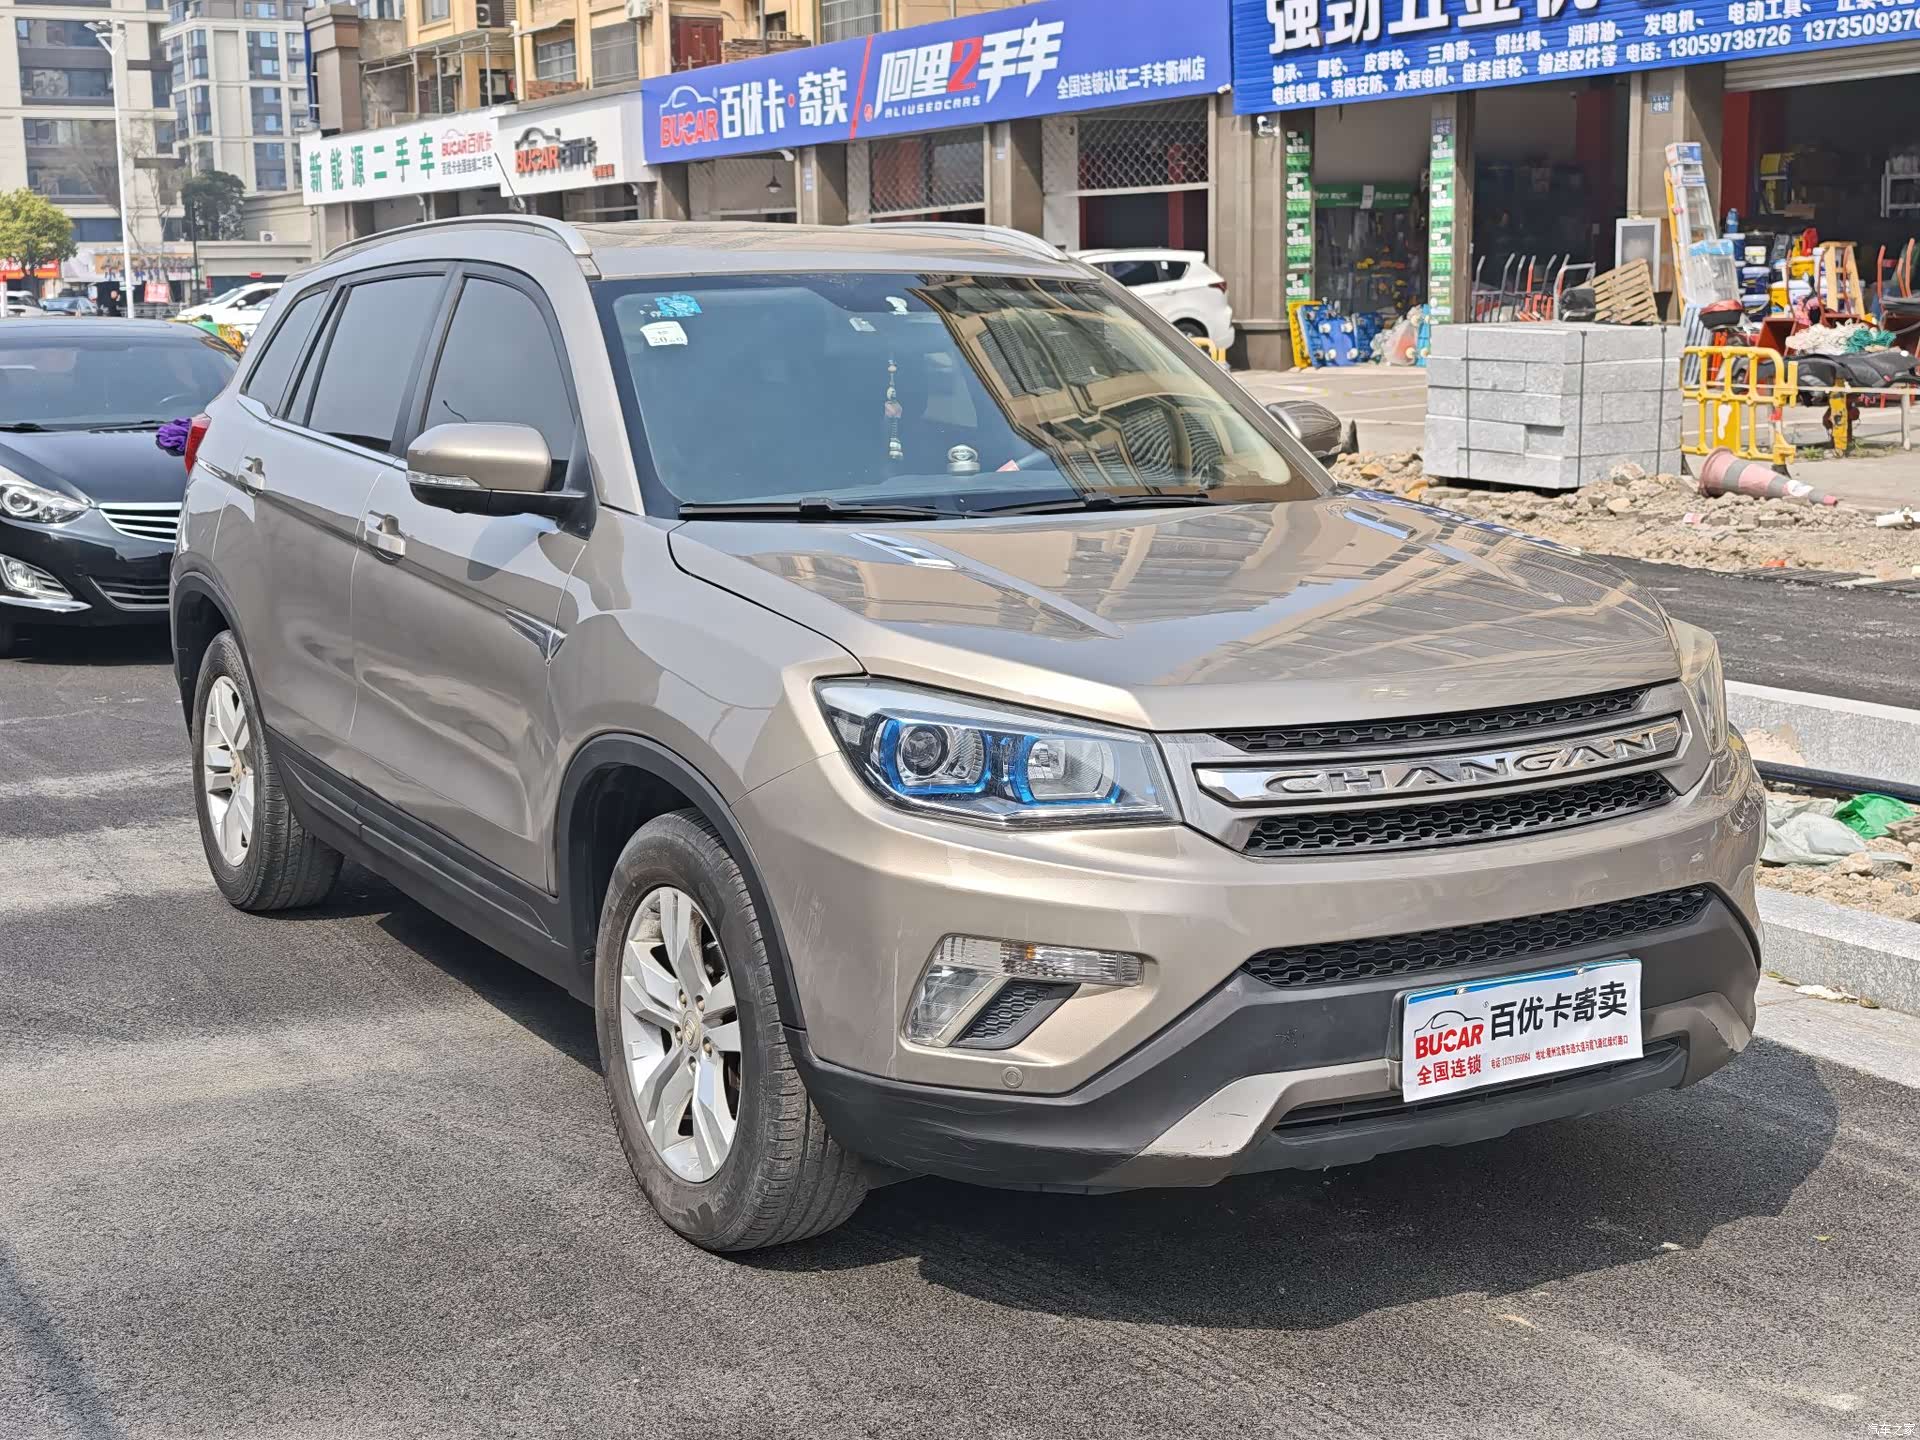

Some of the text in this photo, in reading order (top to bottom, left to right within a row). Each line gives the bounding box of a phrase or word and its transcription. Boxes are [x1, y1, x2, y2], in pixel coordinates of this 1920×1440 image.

[1428, 40, 1477, 64] 三角带、
[1567, 20, 1624, 47] 润滑油、
[1644, 9, 1705, 37] 发电机、
[1667, 24, 1792, 58] 13059738726
[873, 17, 1065, 119] 阿里2手车
[660, 107, 719, 148] BUCAR
[309, 132, 435, 192] 新能源二手车
[515, 145, 560, 174] BUCAR
[1265, 731, 1656, 794] CHANGAN
[1490, 981, 1628, 1041] 百优卡寄卖
[1415, 1023, 1484, 1060] BUCAR
[1417, 1053, 1482, 1086] 全国连锁
